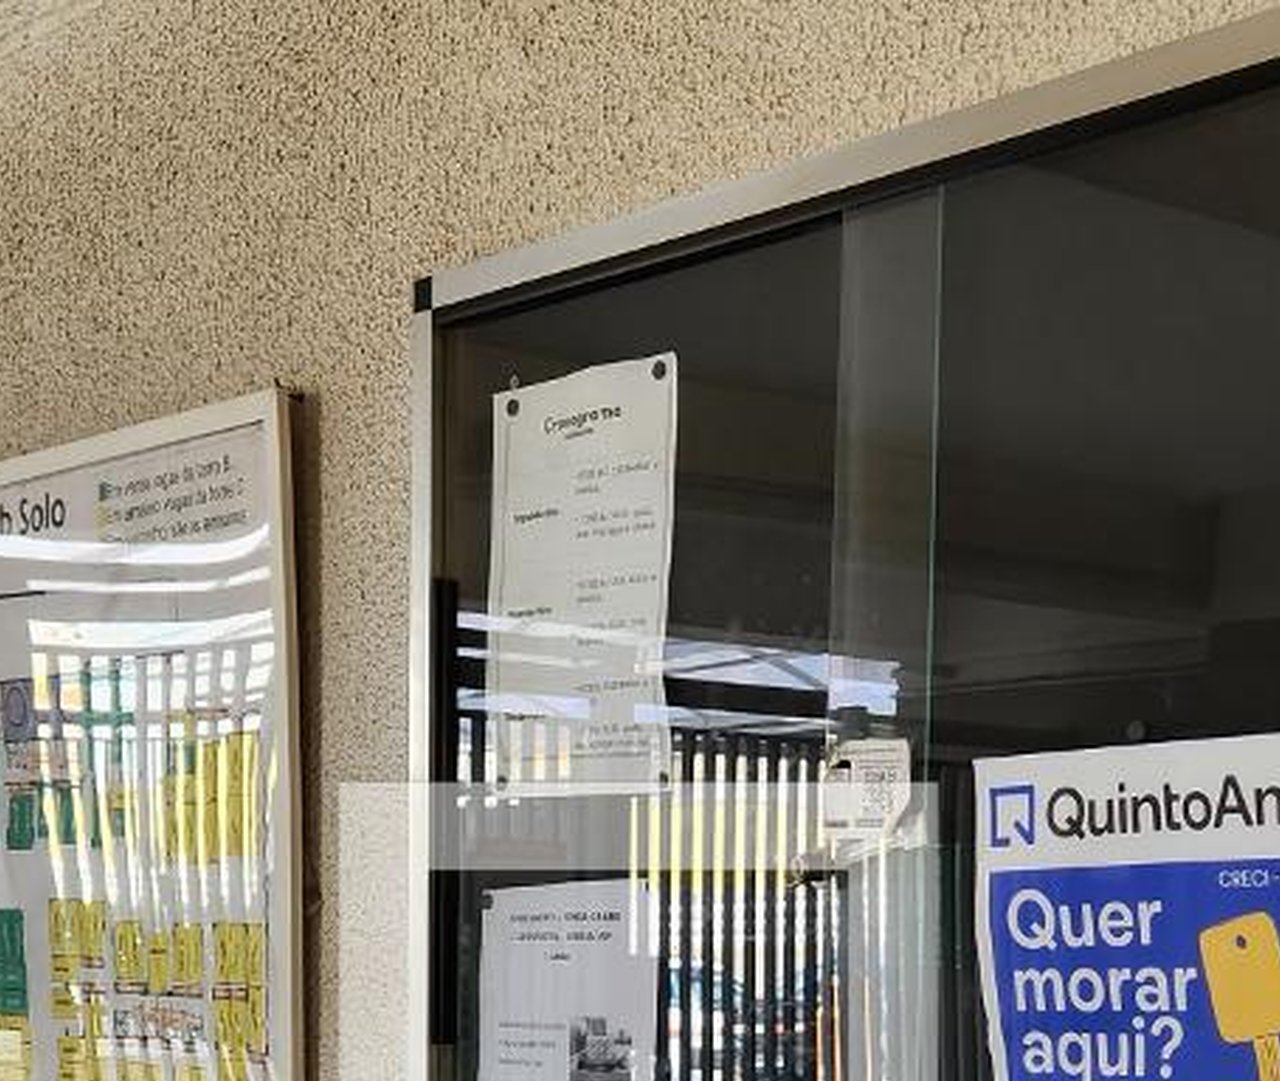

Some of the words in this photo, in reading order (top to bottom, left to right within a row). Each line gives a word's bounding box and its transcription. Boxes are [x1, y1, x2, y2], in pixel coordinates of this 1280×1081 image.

[19, 492, 66, 536] Solo
[1006, 888, 1163, 950] Quer
[1013, 965, 1198, 1012] morar
